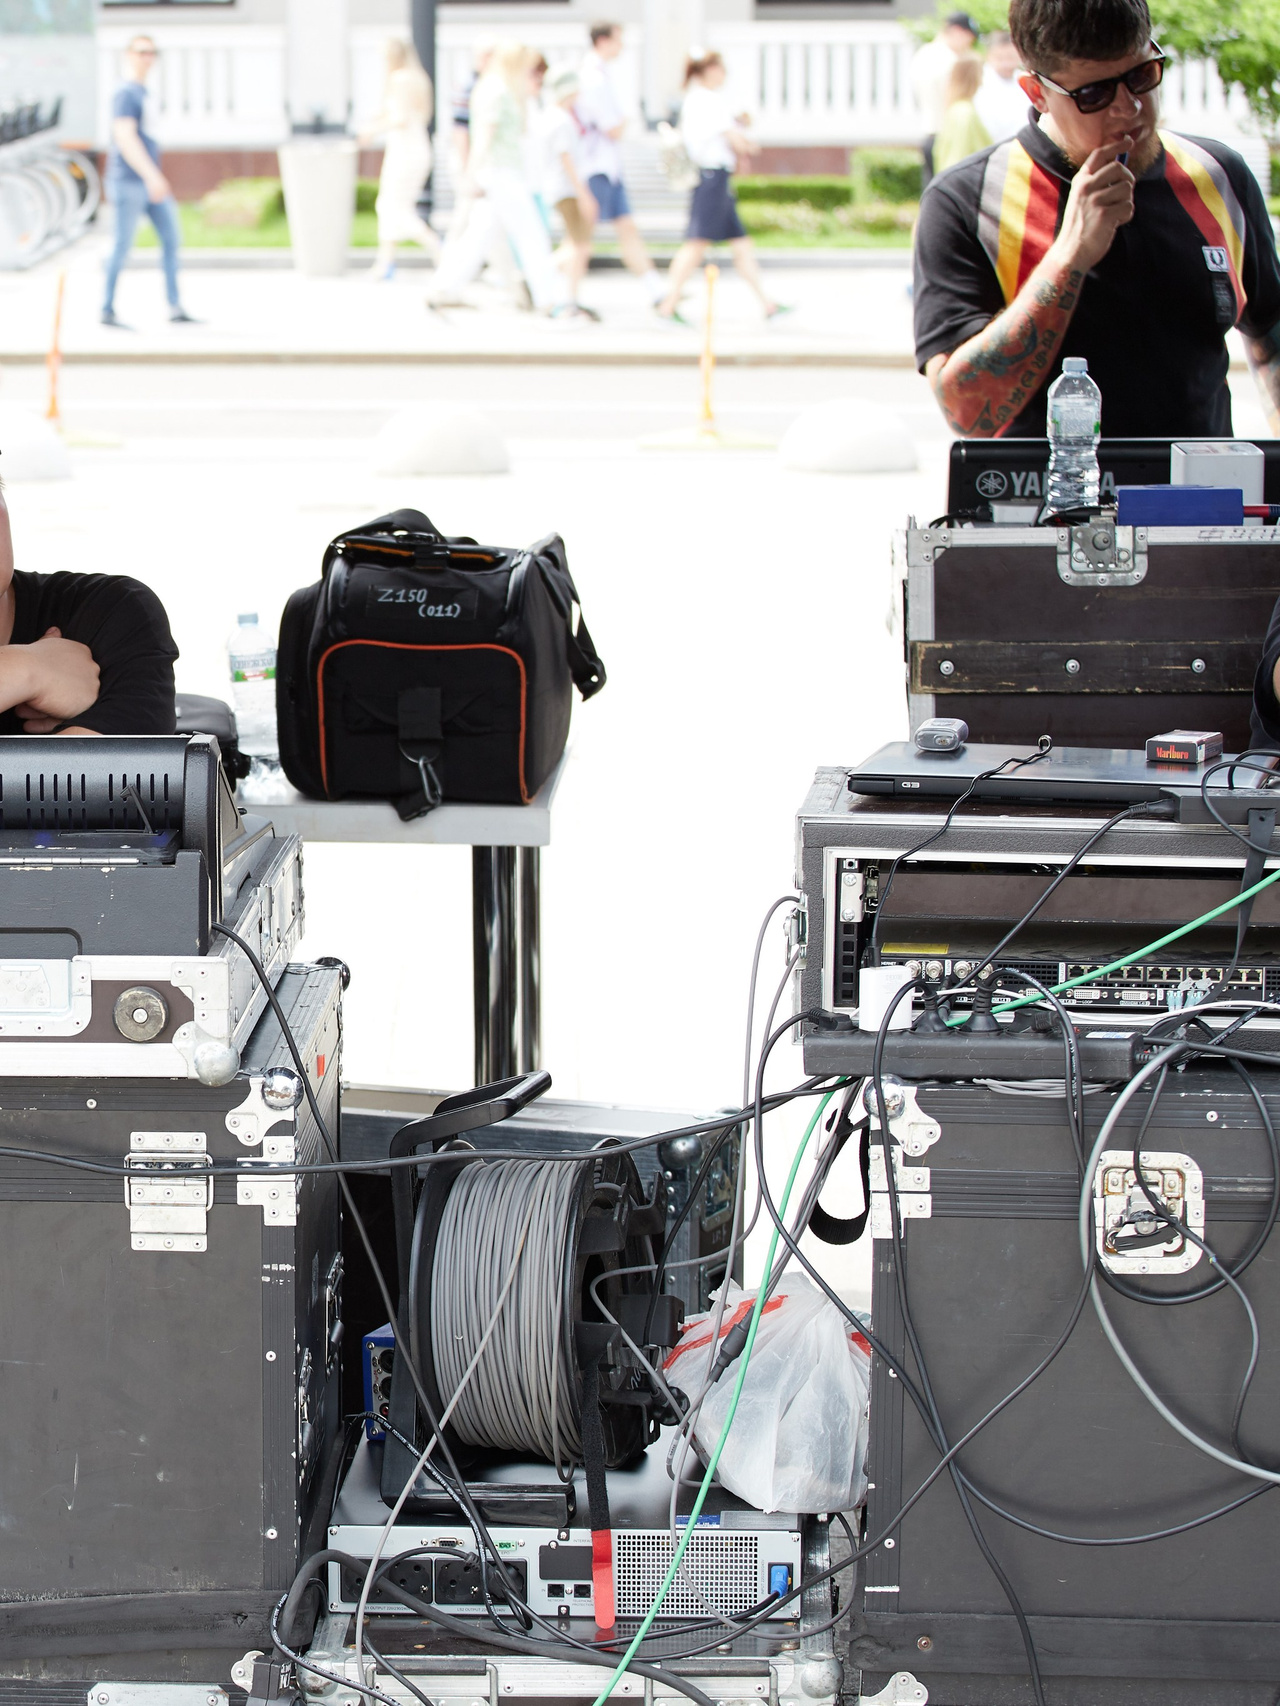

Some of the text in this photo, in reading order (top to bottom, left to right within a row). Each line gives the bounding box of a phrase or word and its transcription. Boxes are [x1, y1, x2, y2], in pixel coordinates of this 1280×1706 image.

[1010, 471, 1115, 496] YAA
[377, 588, 428, 603] Z150
[418, 603, 461, 618] (011)
[1156, 744, 1189, 759] Marlboro
